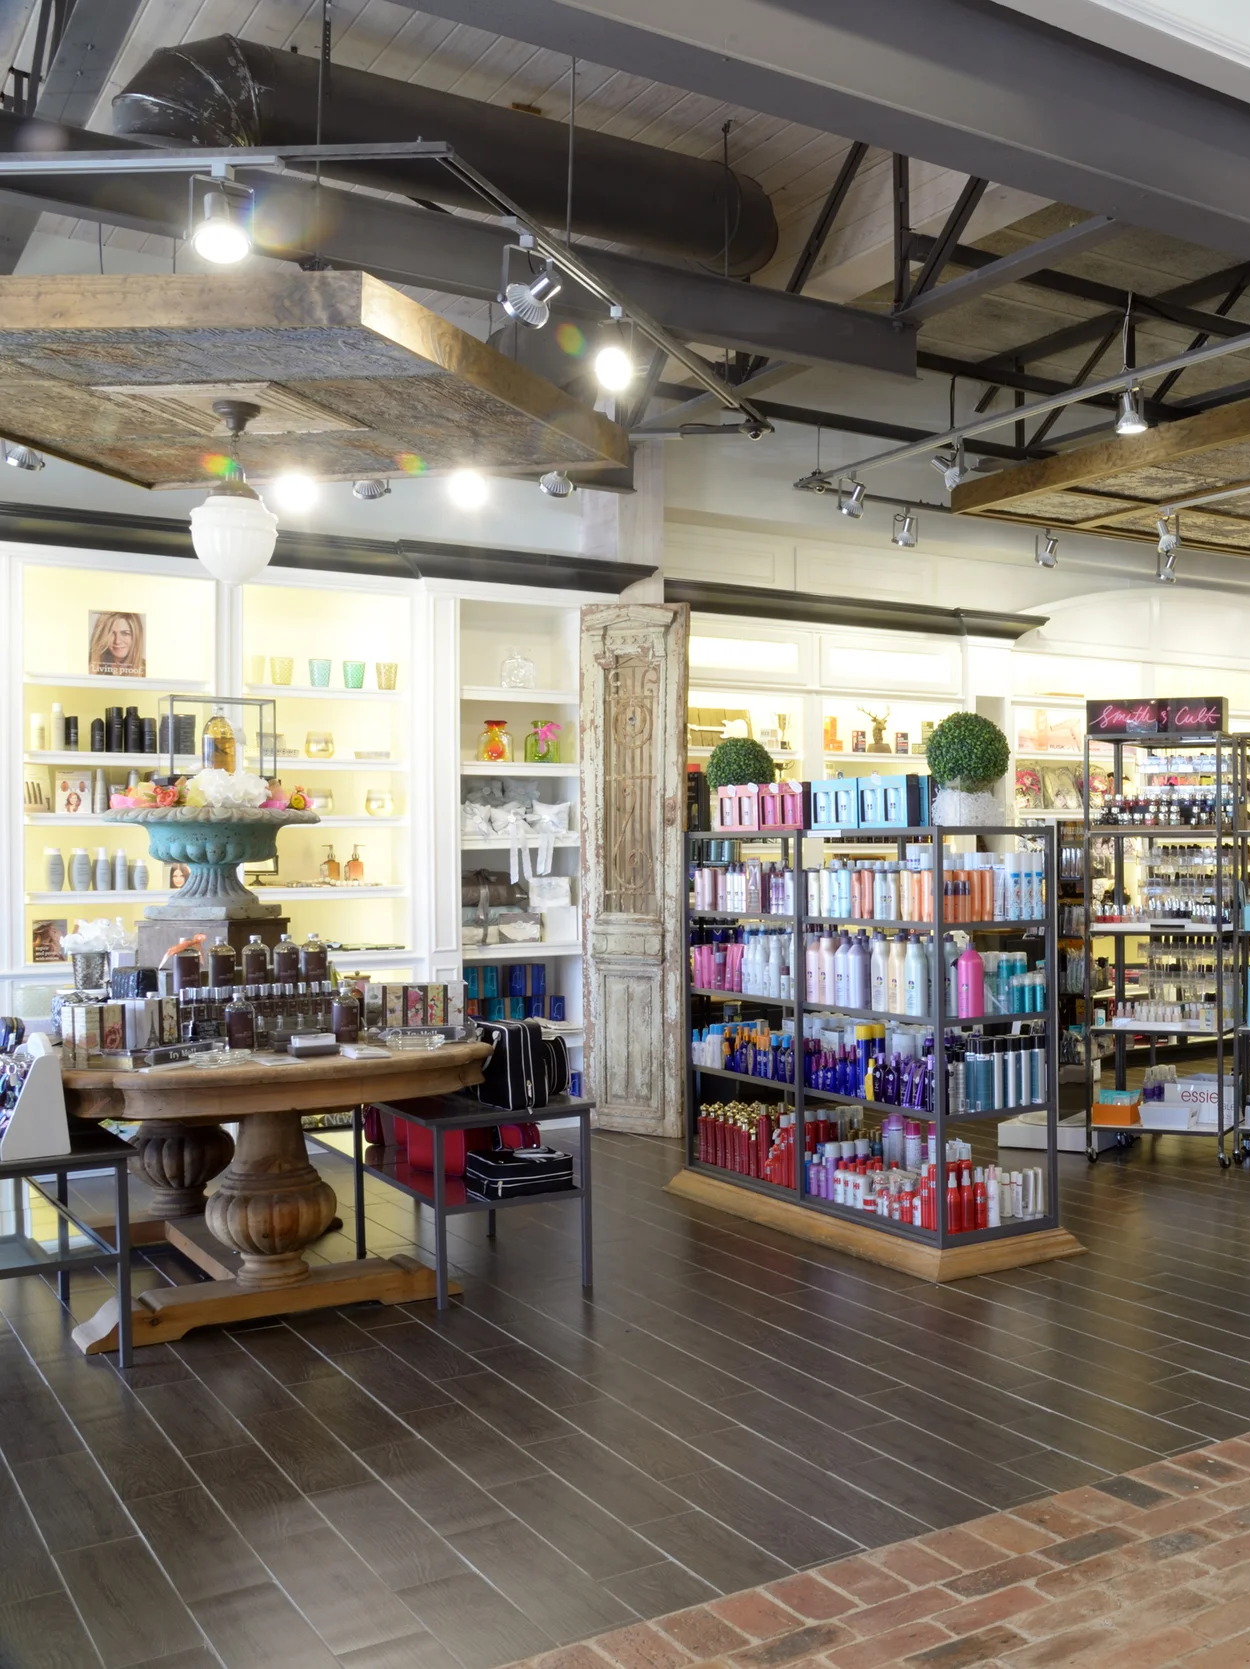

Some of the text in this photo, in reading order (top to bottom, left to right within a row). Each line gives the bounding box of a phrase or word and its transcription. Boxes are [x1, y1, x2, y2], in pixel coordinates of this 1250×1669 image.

[90, 664, 118, 675] Living
[1089, 705, 1157, 728] Smith
[1175, 706, 1221, 726] Cult
[169, 1050, 180, 1060] Try
[1181, 1089, 1219, 1104] essie
